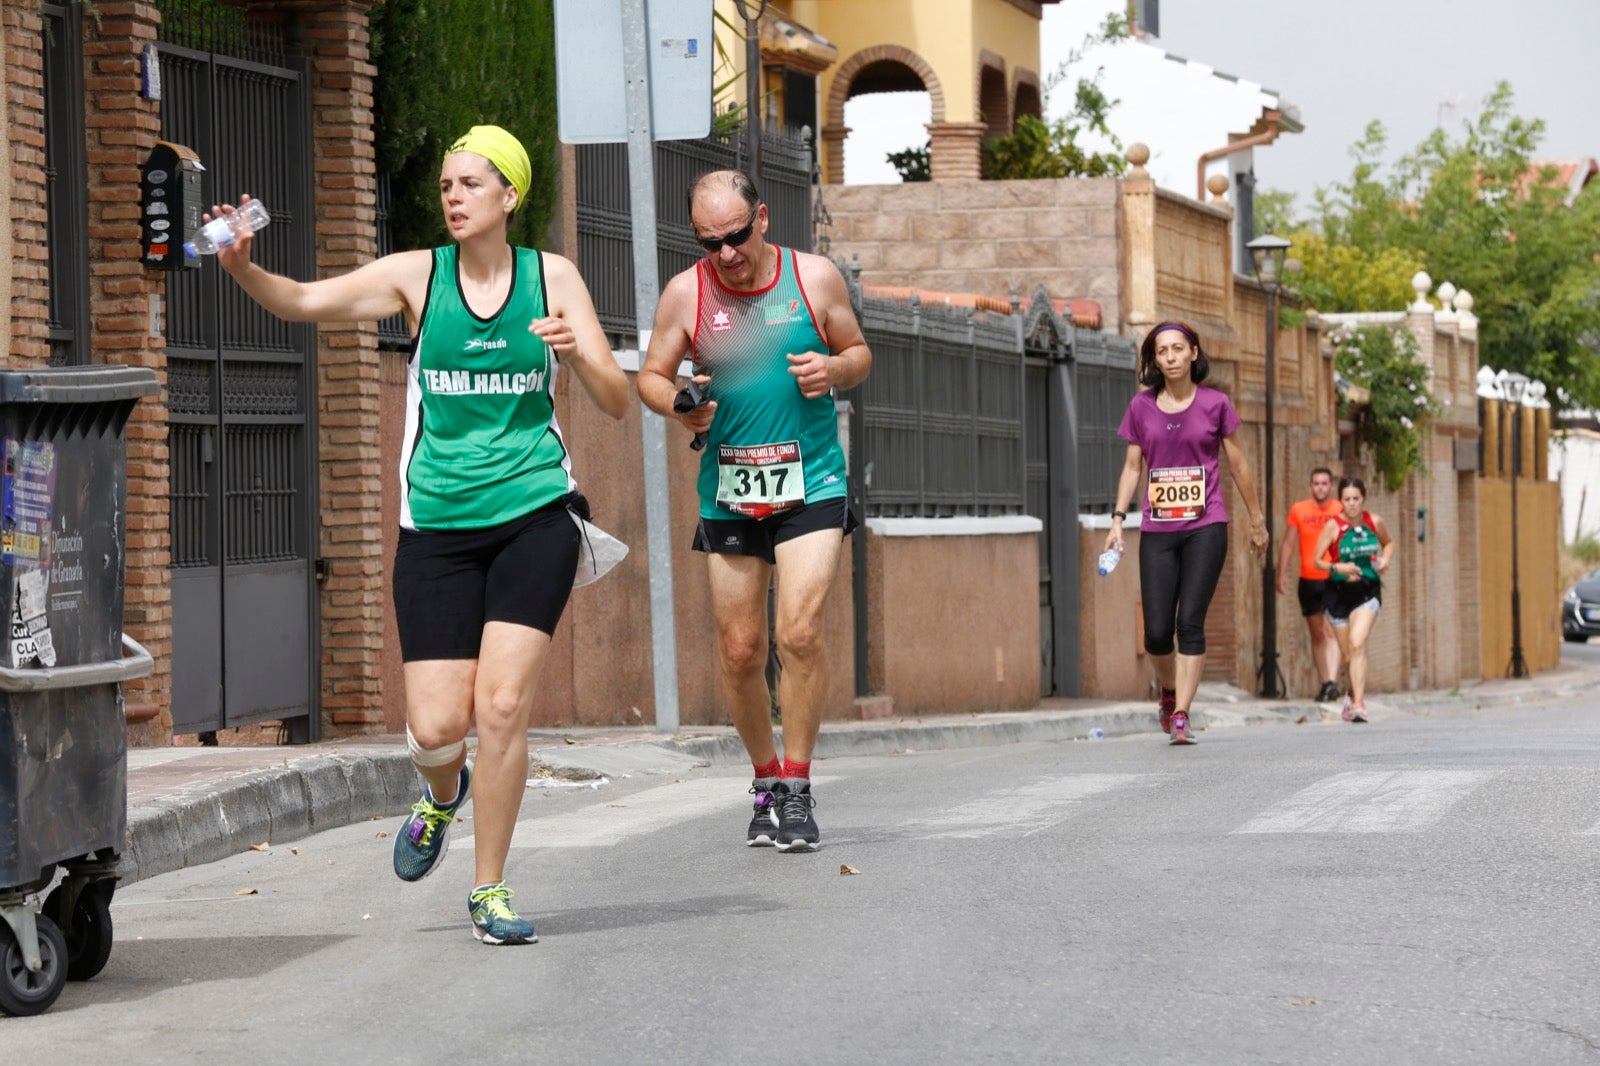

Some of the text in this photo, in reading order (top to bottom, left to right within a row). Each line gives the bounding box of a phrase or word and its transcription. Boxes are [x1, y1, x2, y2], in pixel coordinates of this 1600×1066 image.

[423, 369, 470, 392] TEAM
[734, 448, 747, 458] GRAN
[747, 448, 768, 458] PREMIO
[768, 446, 777, 456] DE
[777, 444, 795, 456] FONDO
[733, 468, 789, 497] 317
[1155, 485, 1201, 503] 2089
[51, 529, 83, 558] Diputación
[51, 559, 83, 584] de Granada
